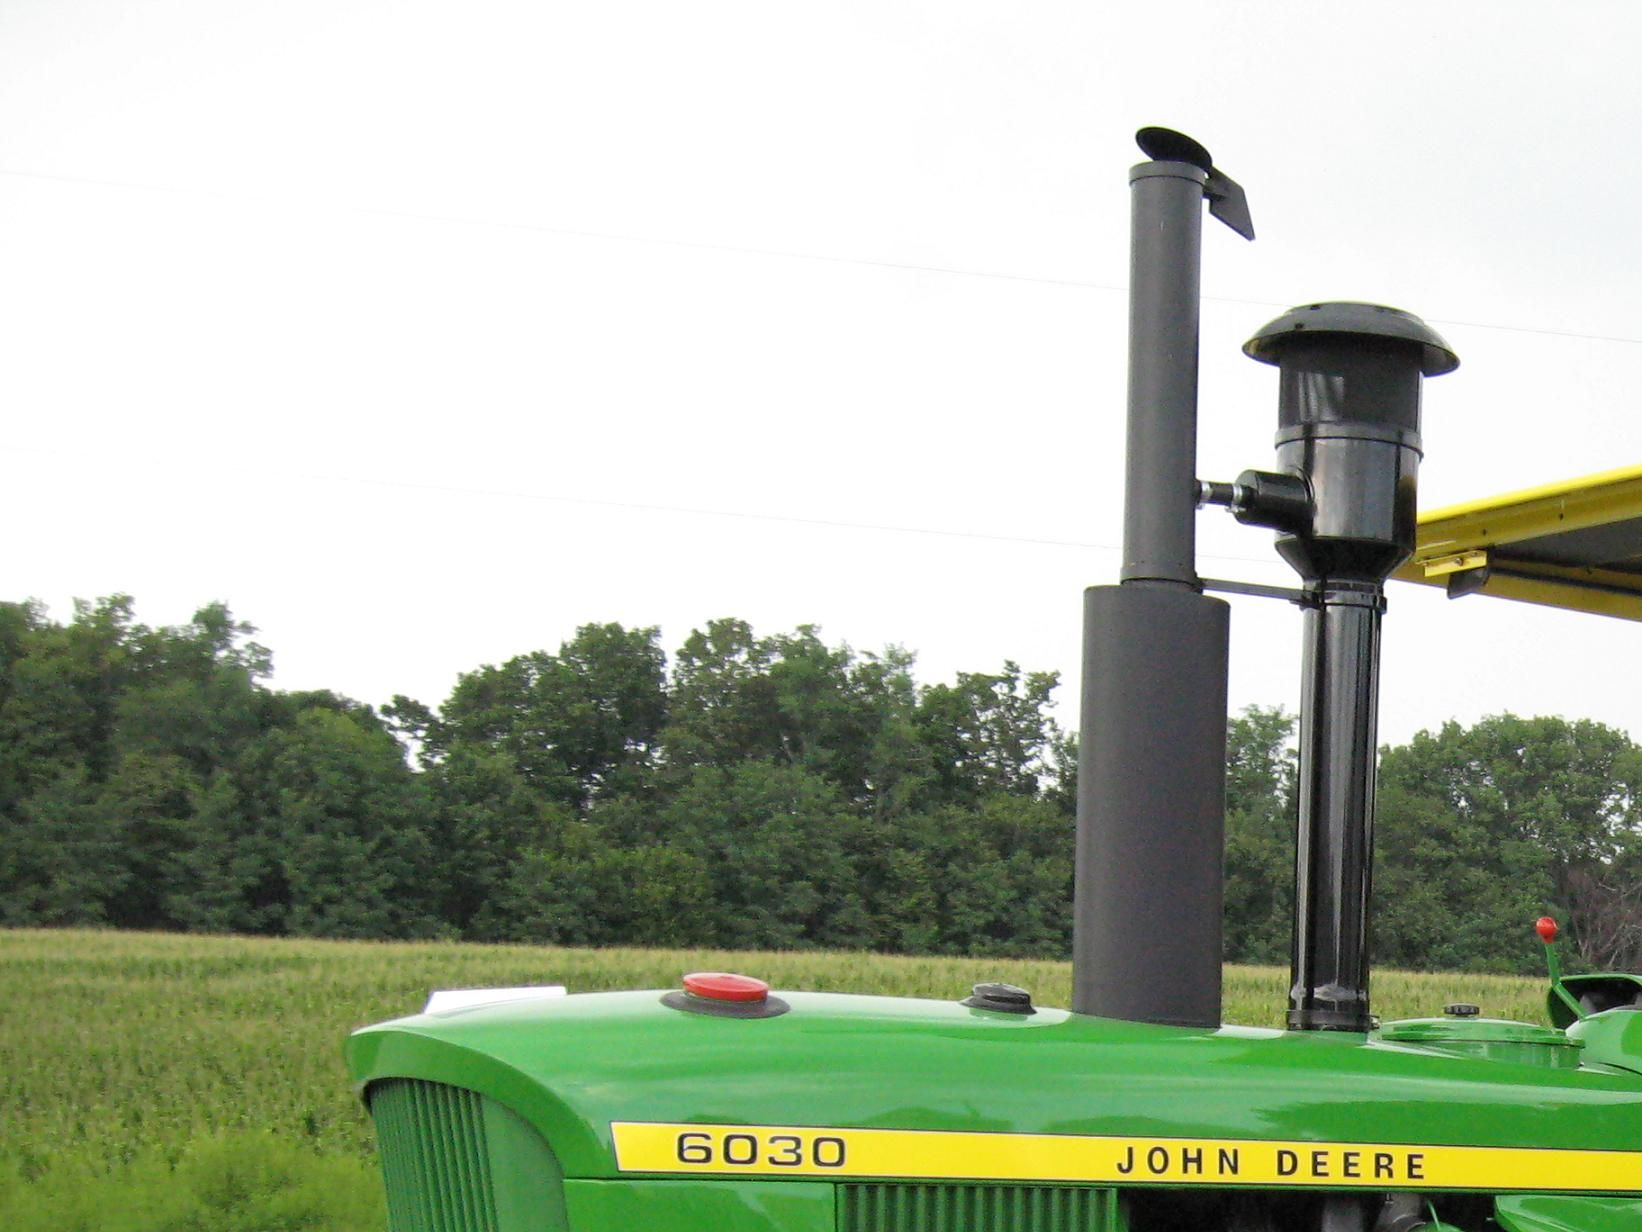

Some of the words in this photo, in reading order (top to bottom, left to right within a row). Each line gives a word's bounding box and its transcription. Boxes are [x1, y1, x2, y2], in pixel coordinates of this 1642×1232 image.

[676, 1132, 847, 1168] 6030
[1116, 1145, 1240, 1175] JOHN
[1276, 1149, 1425, 1180] DEERE
